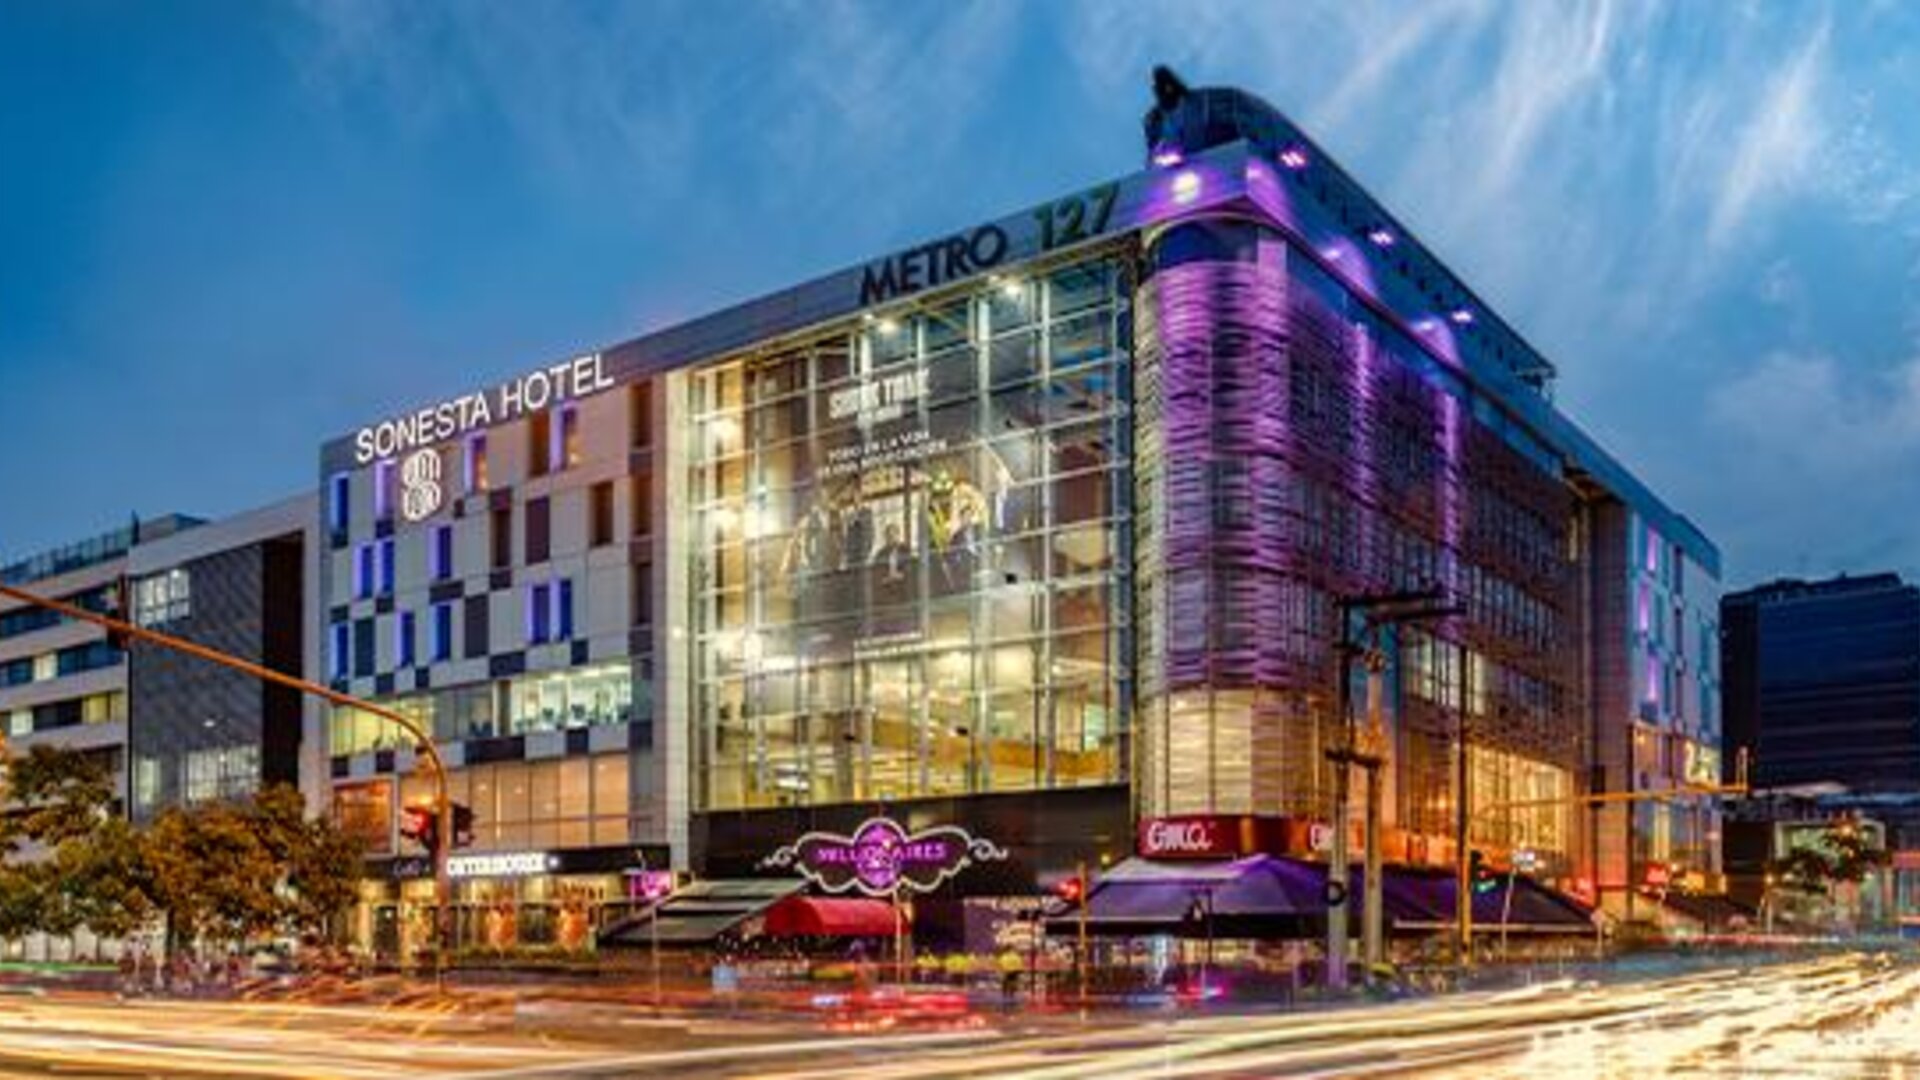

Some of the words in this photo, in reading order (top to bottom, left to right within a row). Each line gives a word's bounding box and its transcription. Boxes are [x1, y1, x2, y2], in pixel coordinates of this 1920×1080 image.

[859, 222, 1008, 306] METRO
[1032, 181, 1121, 250] 127
[355, 392, 491, 463] SONESTA
[500, 353, 615, 419] HOTEL
